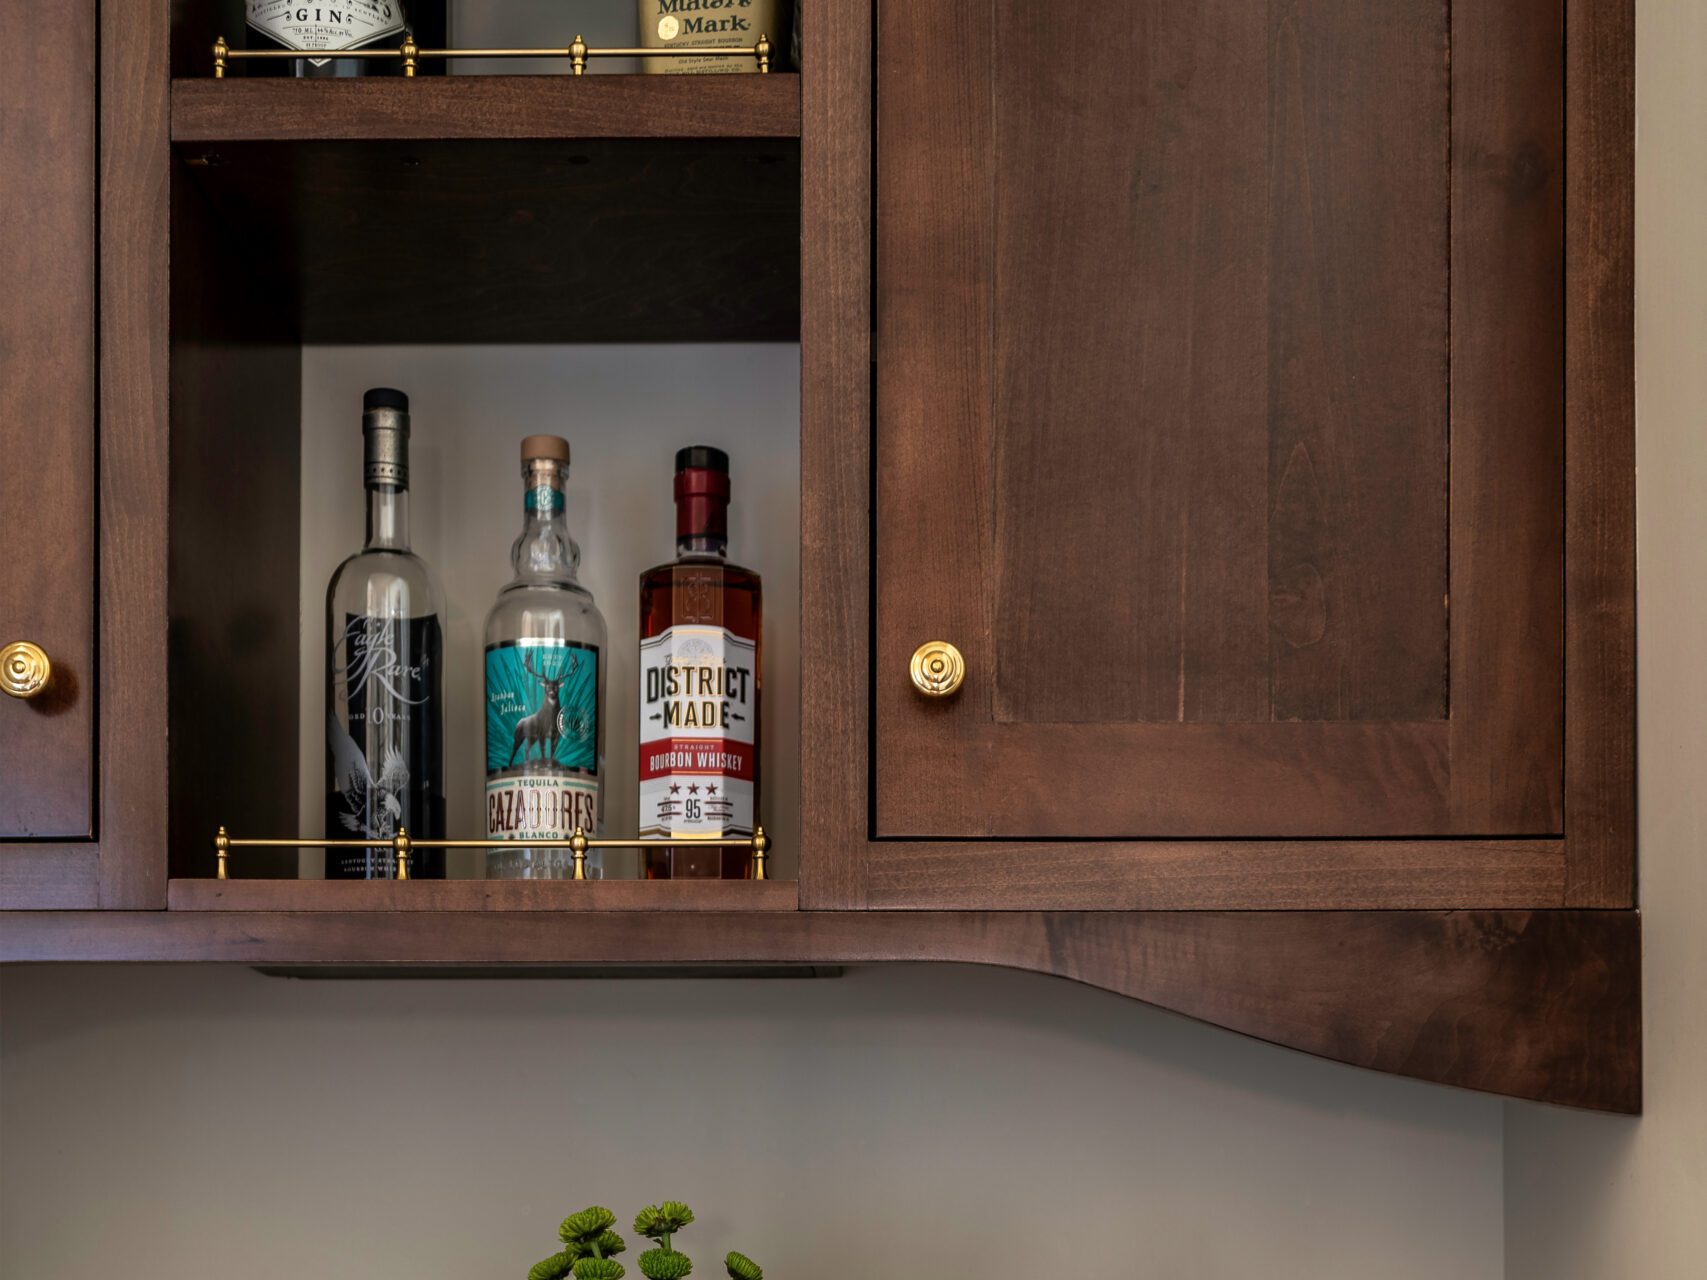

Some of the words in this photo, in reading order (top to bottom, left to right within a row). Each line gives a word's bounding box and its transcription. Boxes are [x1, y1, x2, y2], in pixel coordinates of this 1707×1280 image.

[296, 8, 343, 24] GIN
[682, 15, 750, 35] Mark
[346, 647, 430, 705] Rare
[646, 666, 750, 704] DISTRICT
[663, 701, 730, 730] MADE
[650, 751, 692, 771] BOURBON
[697, 752, 742, 771] WHISKEY
[517, 779, 559, 787] TEQUILA
[489, 789, 593, 833] CAZADORES
[685, 798, 701, 819] 95
[519, 831, 559, 839] BLANCO
